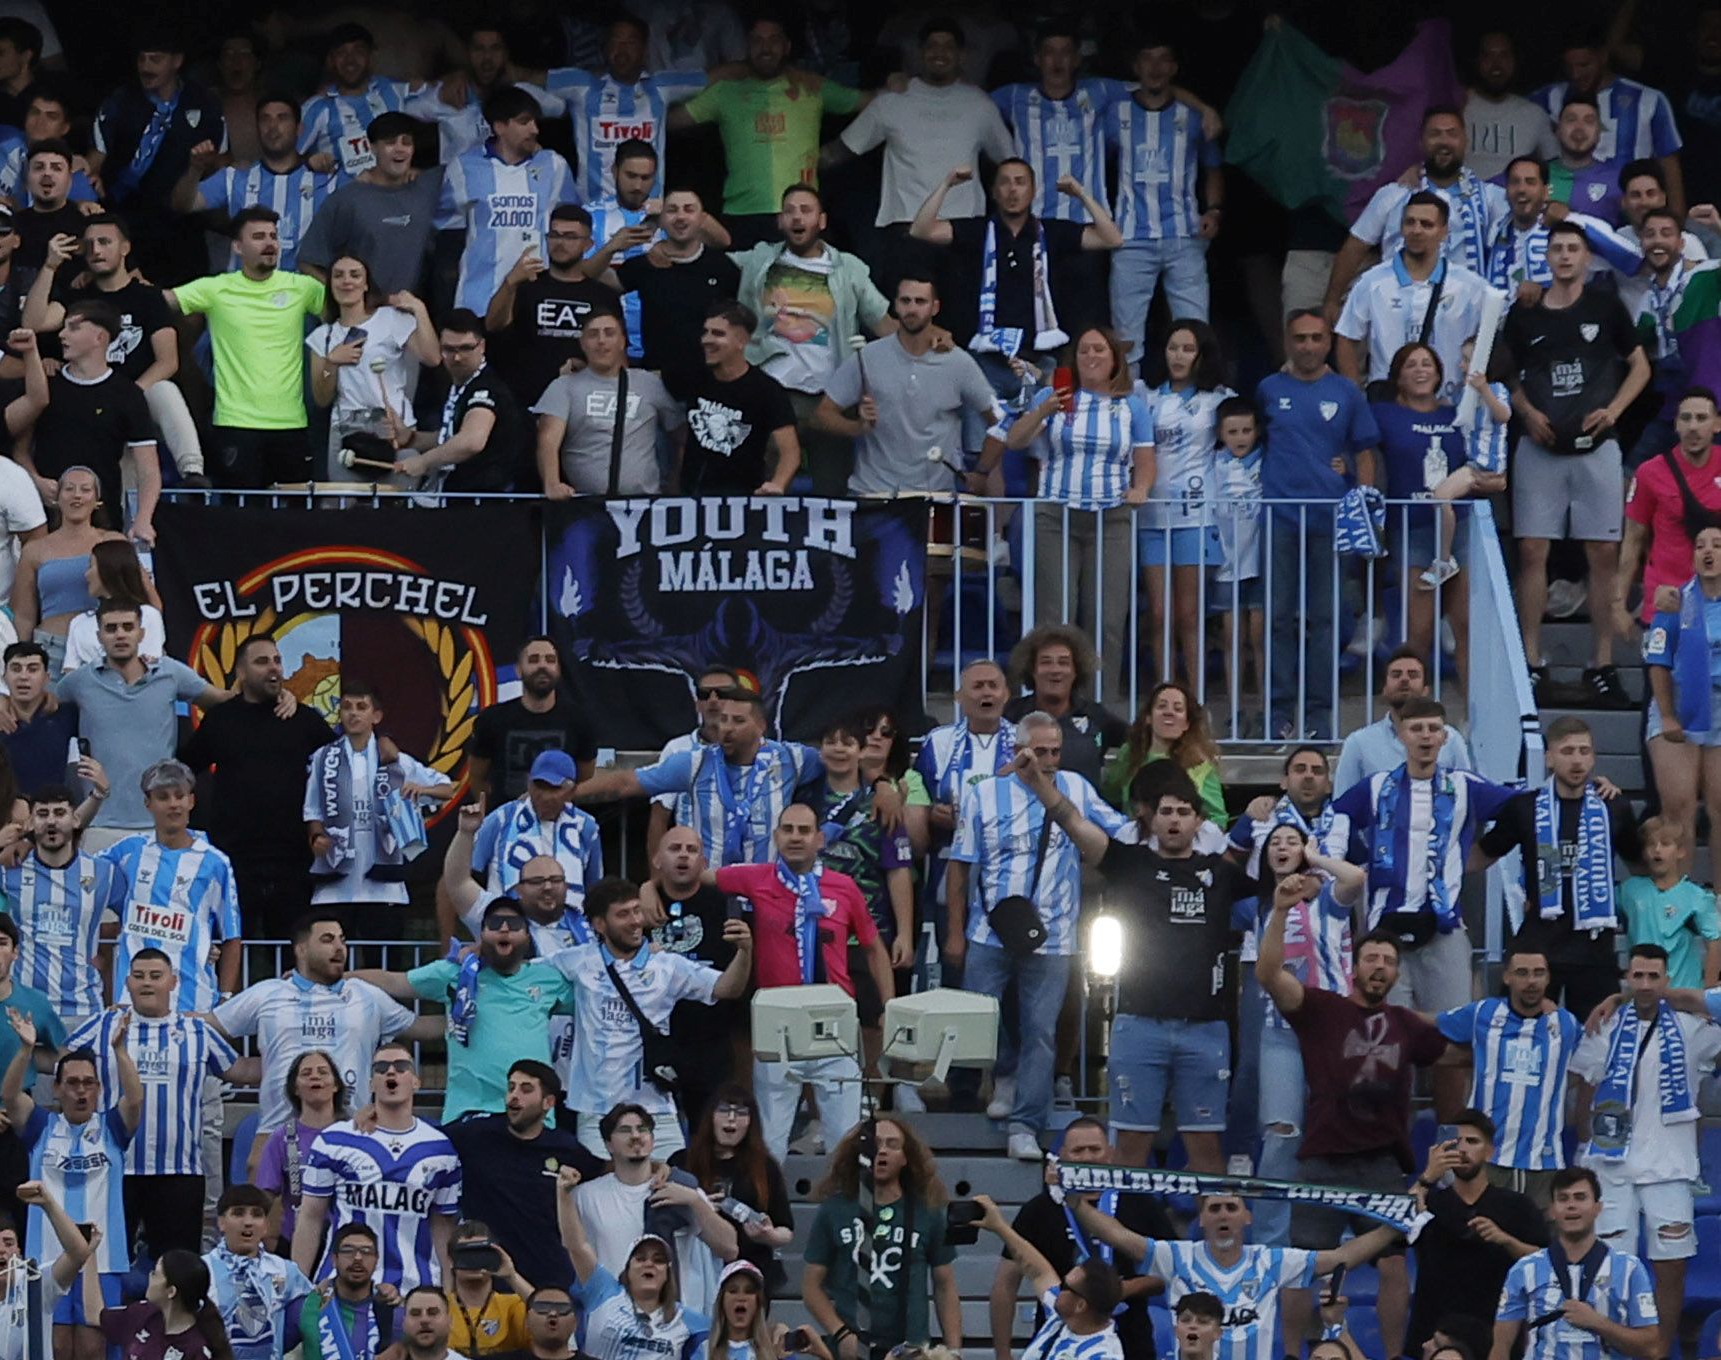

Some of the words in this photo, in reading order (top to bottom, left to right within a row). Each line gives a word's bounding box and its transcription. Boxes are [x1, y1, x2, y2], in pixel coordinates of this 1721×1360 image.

[599, 121, 654, 141] Tivoli
[490, 196, 535, 209] somos
[490, 211, 534, 229] 20.000
[605, 496, 858, 560] YOUTH
[658, 543, 814, 592] MÁLAGA
[193, 580, 257, 622] EL
[272, 573, 489, 627] PERCHEL
[136, 904, 186, 932] Tivoli
[151, 927, 169, 938] DEL
[1060, 1166, 1201, 1195] MALAKA
